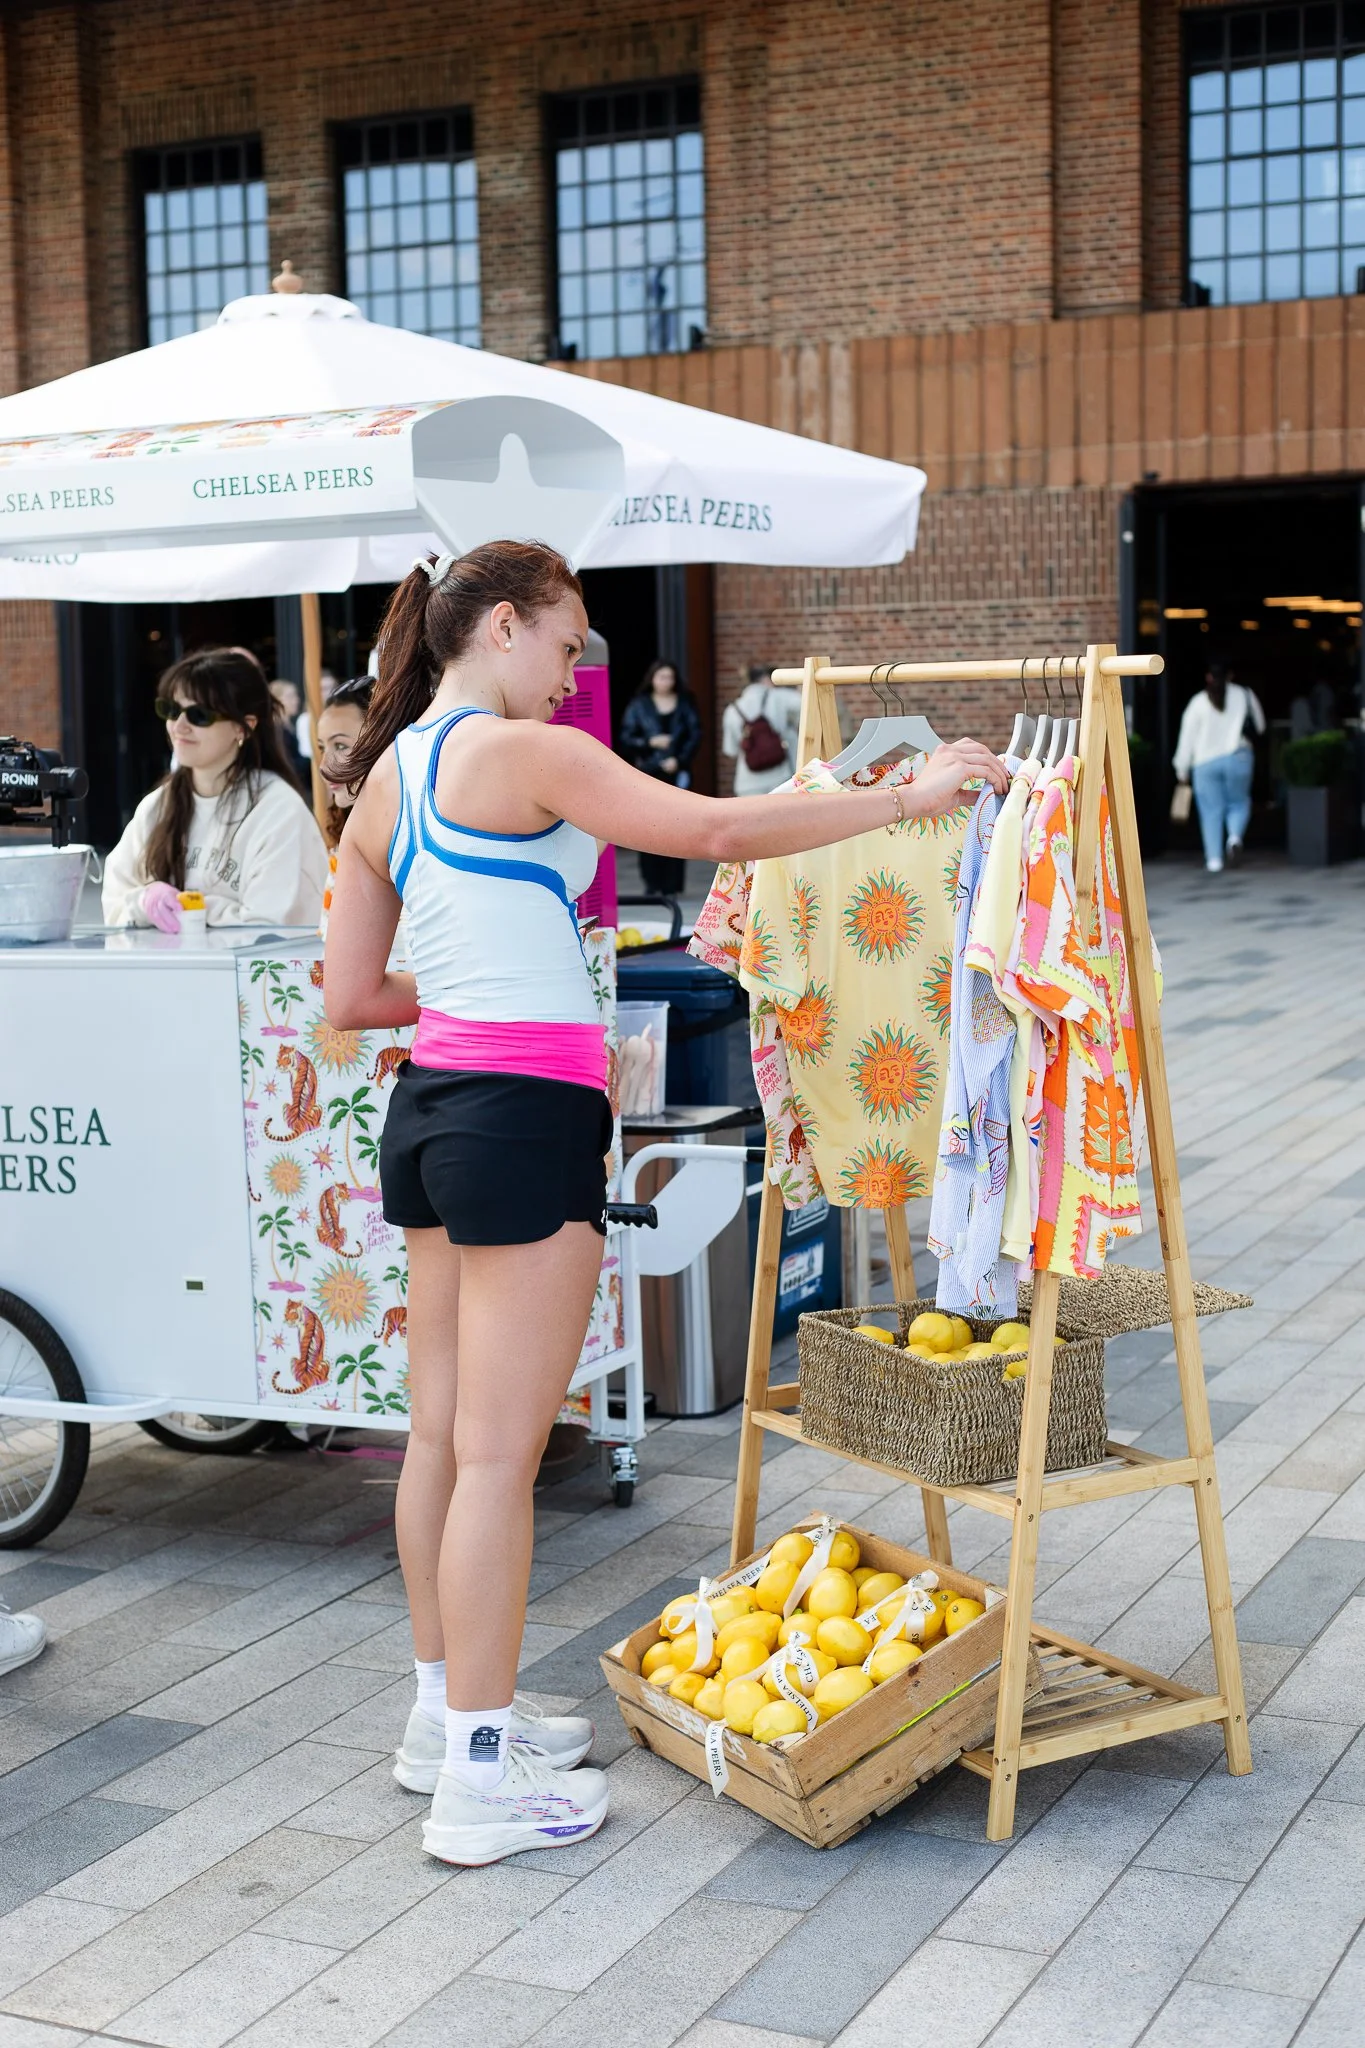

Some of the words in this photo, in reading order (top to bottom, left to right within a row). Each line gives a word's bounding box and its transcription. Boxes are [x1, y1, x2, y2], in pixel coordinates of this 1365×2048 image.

[50, 486, 114, 509] PEERS
[193, 472, 298, 499] CHELSEA
[304, 466, 374, 491] PEERS
[700, 497, 772, 532] PEERS
[1, 772, 39, 786] RONIN
[1, 1106, 111, 1146] LSEA
[741, 1564, 765, 1583] PEERS
[710, 1747, 723, 1777] PEERS
